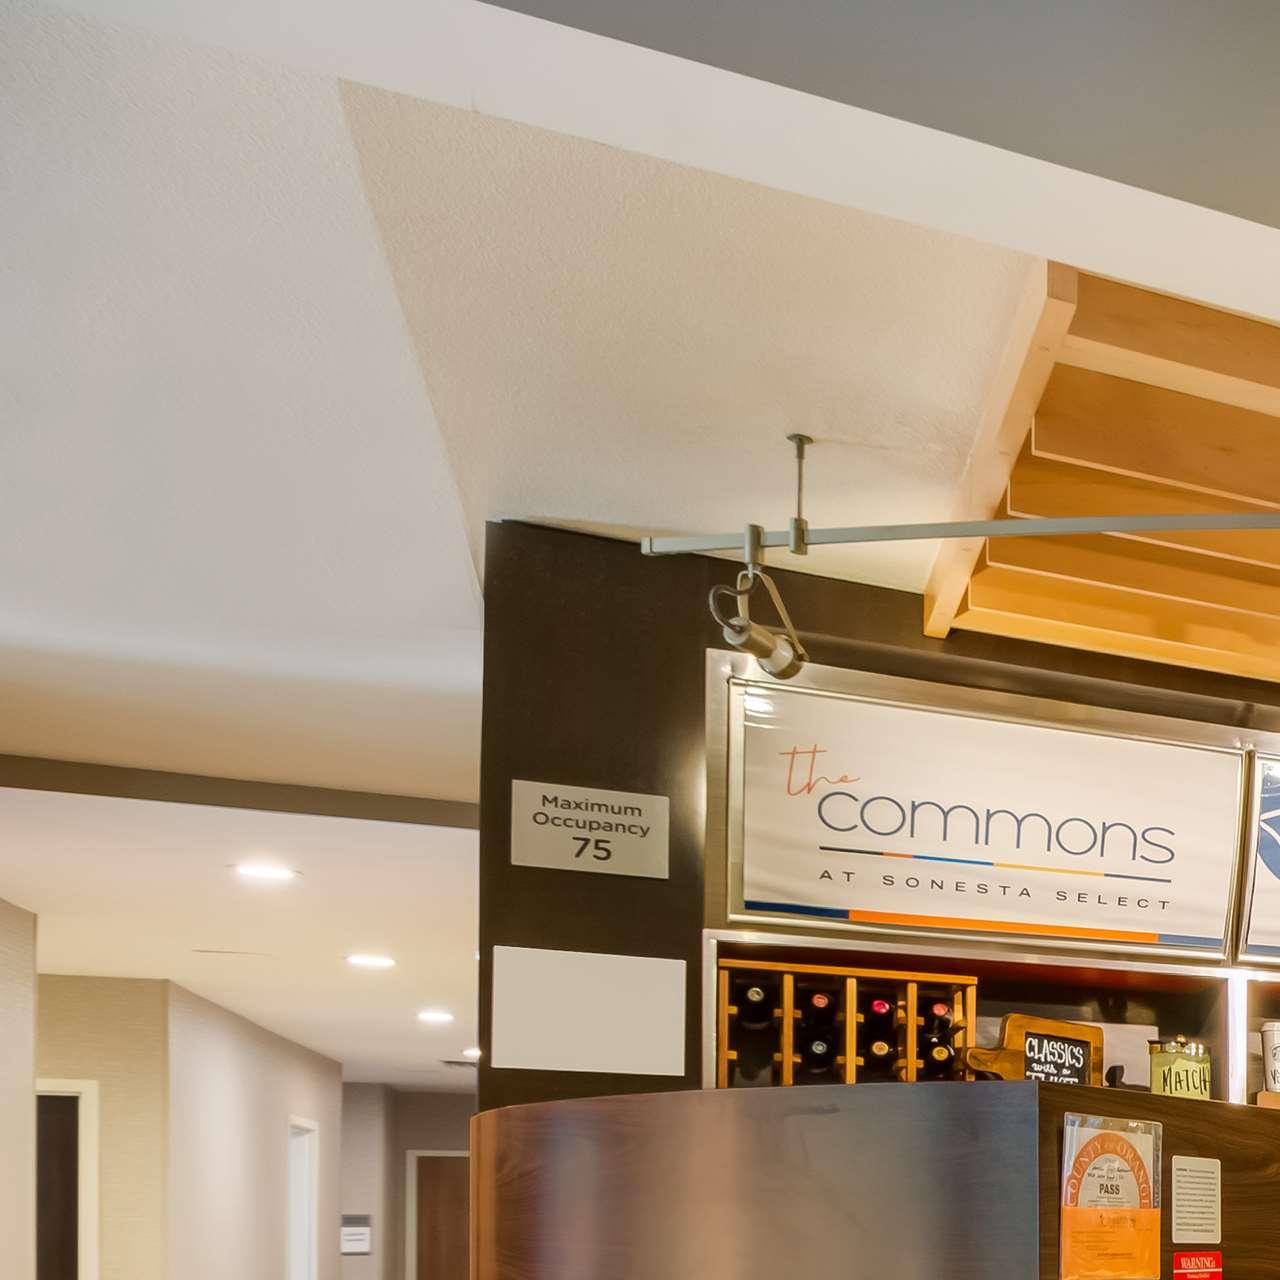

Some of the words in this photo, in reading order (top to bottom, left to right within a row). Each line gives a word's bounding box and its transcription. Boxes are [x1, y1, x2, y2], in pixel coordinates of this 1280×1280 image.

[779, 743, 861, 797] the
[541, 794, 643, 817] Maximum
[532, 811, 651, 838] Occupancy
[817, 790, 1176, 864] commons
[572, 836, 612, 861] 75
[819, 869, 856, 883] AT
[882, 874, 1032, 898] SONESTA
[1055, 890, 1171, 911] SELECT
[1025, 1037, 1083, 1068] CLASSICS
[1068, 1139, 1102, 1207] COUNTY
[1119, 1142, 1149, 1208] ORANGE
[1099, 1183, 1121, 1195] PASS
